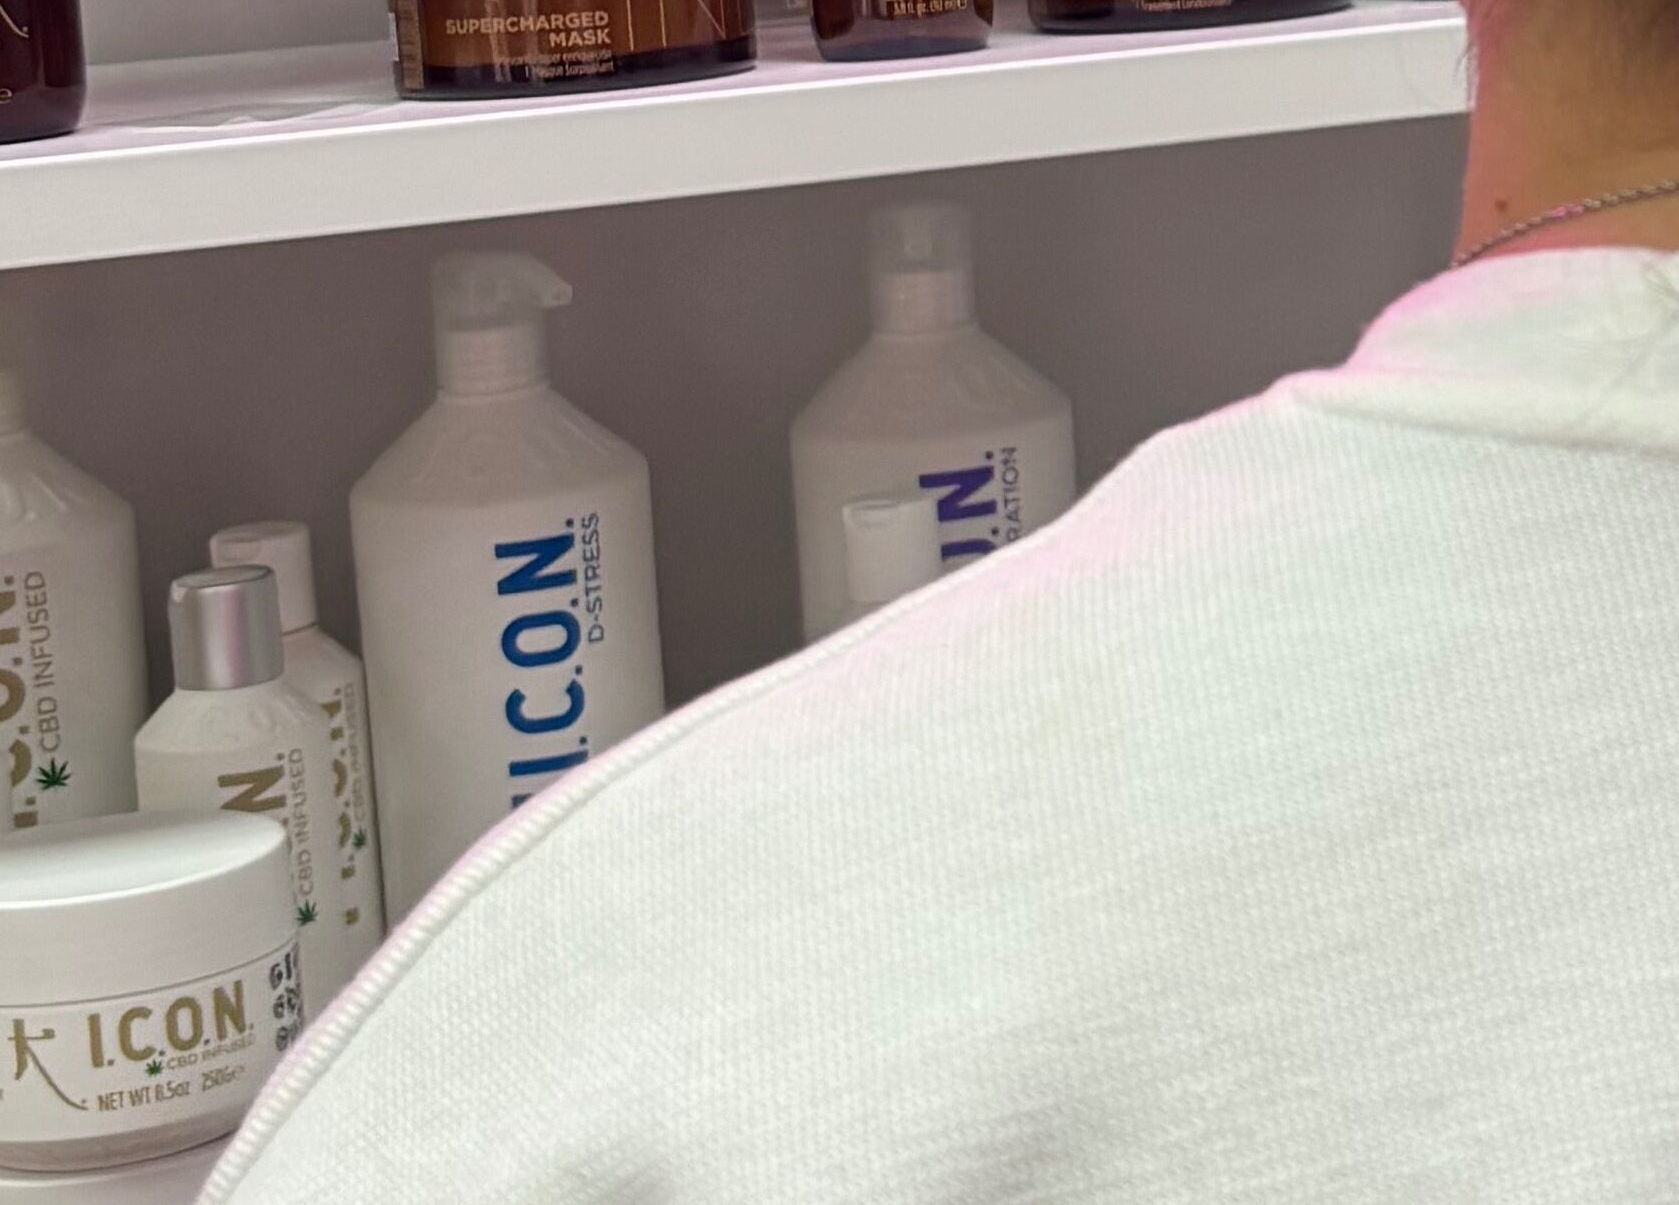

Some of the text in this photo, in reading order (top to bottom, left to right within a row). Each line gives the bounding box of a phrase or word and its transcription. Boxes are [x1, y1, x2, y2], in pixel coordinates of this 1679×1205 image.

[445, 10, 610, 35] SUPERCHARGED
[549, 27, 612, 48] MASK
[581, 512, 605, 644] D-STRESS
[24, 570, 60, 753] CBD INFUSED
[494, 517, 589, 777] I.C.O.N.
[297, 848, 314, 896] CBD
[86, 979, 255, 1070] I.C.O.N.
[165, 1052, 199, 1070] CBD
[97, 1090, 125, 1112] NET
[128, 1086, 151, 1107] WT
